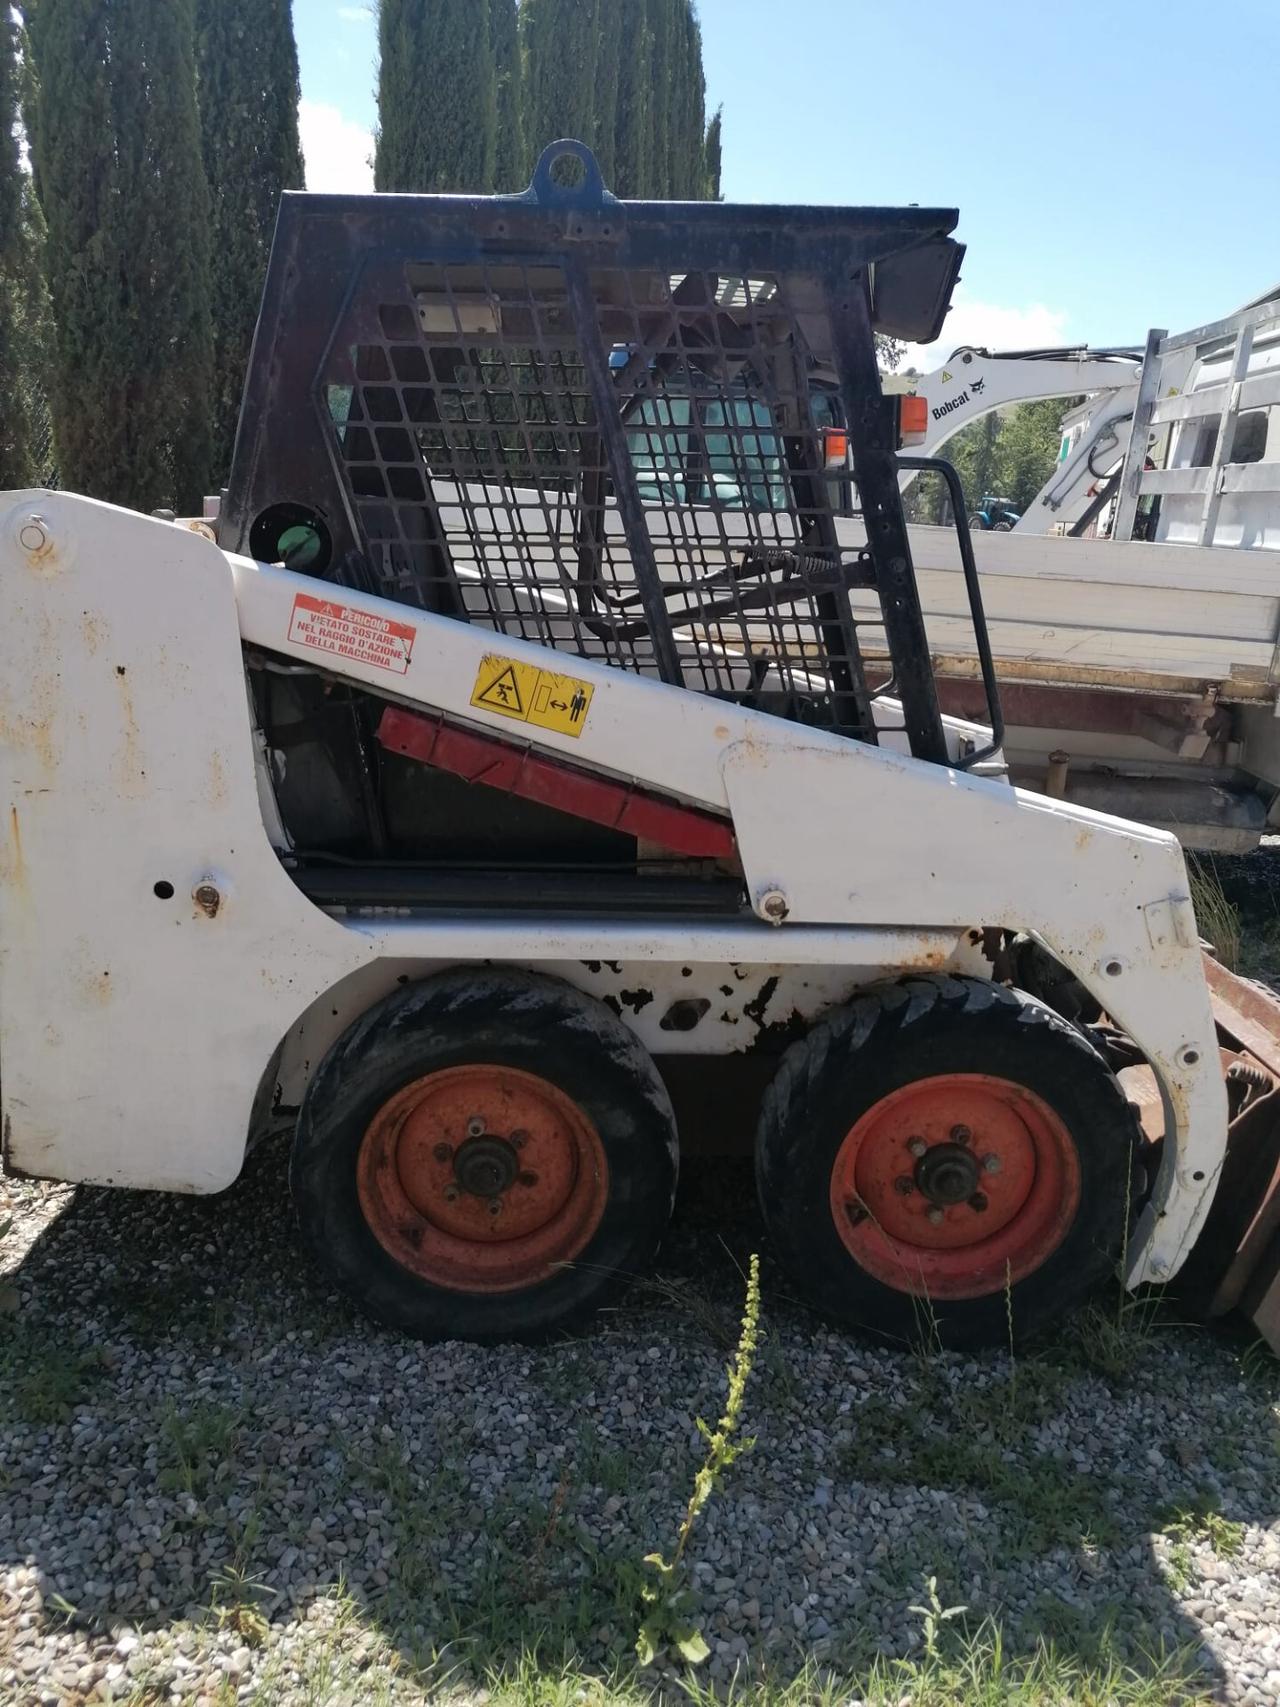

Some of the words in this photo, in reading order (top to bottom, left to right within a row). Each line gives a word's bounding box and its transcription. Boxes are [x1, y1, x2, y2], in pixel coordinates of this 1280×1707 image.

[932, 391, 970, 420] Bobcat
[297, 621, 316, 634] NEL
[319, 628, 355, 644] RAGGIO
[358, 638, 403, 660] D'AZIONE
[310, 613, 349, 632] VIETATO
[351, 626, 396, 646] SOSTARE
[305, 634, 335, 649] DELLA
[338, 644, 391, 666] MACCHINA
